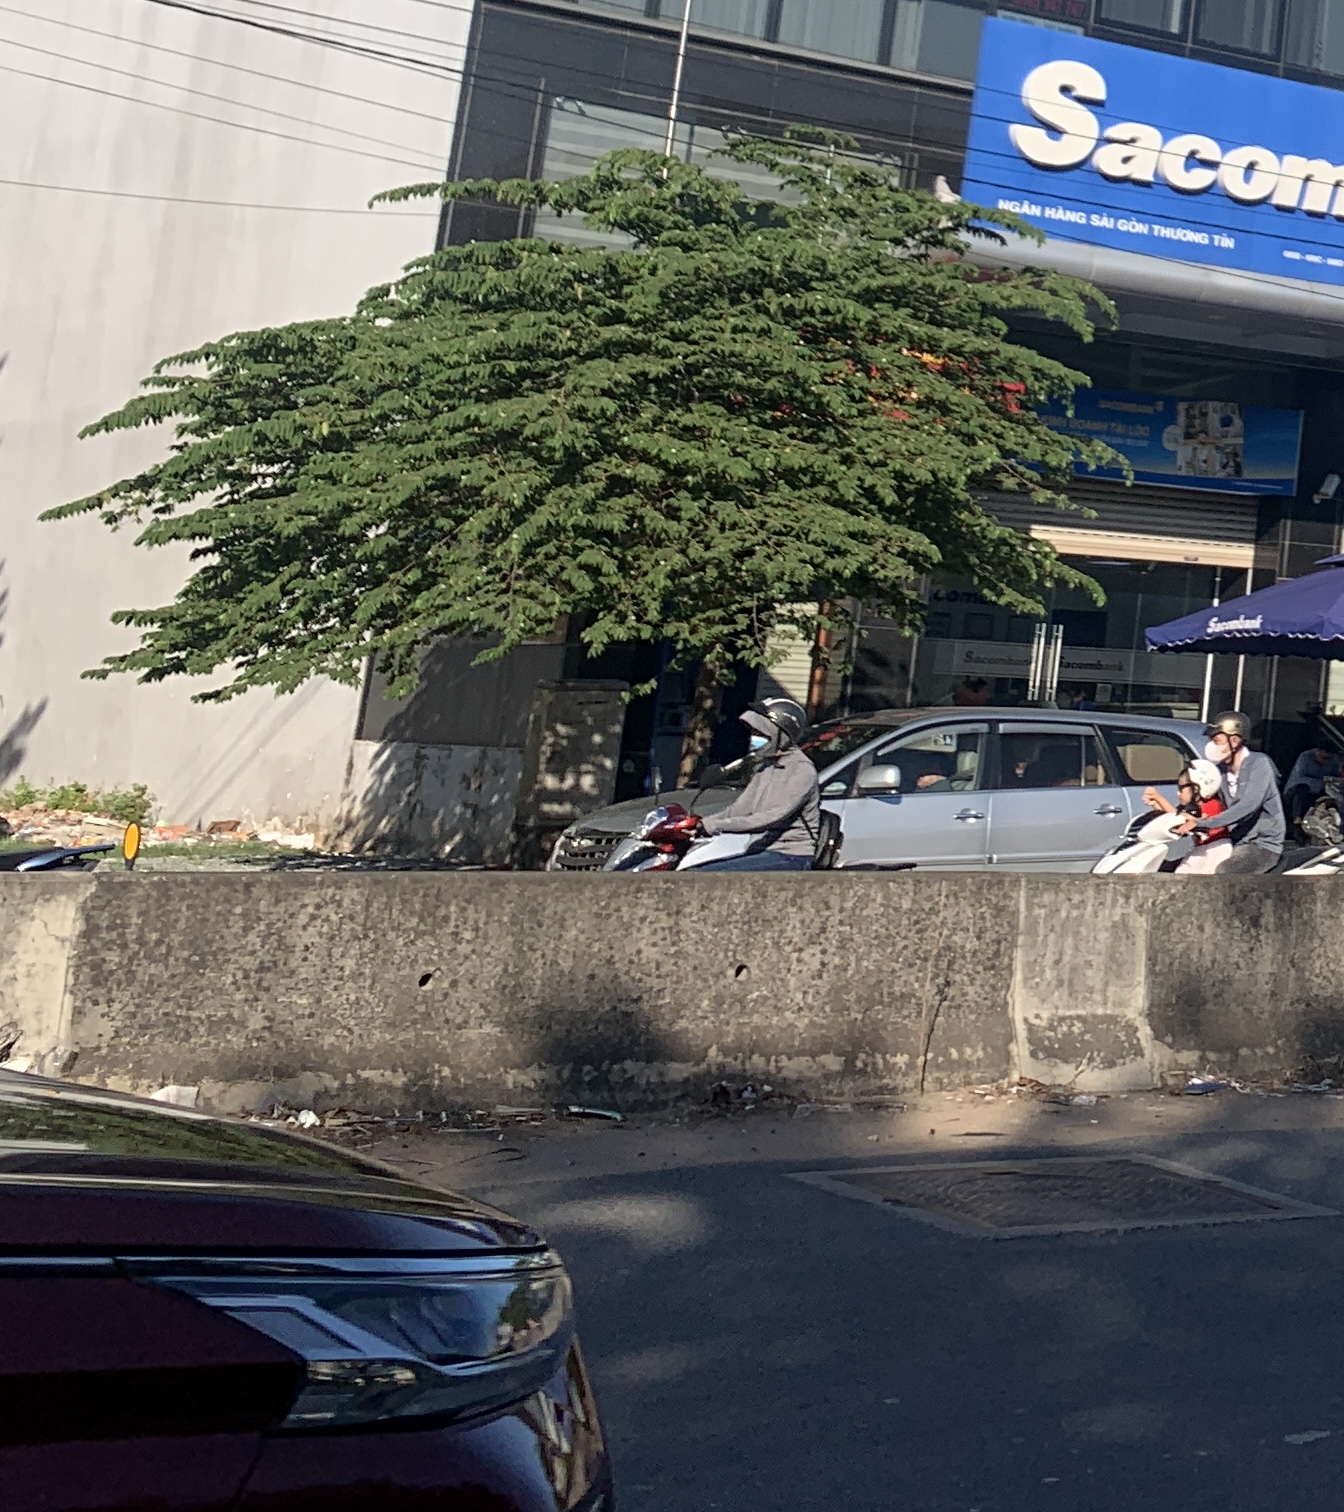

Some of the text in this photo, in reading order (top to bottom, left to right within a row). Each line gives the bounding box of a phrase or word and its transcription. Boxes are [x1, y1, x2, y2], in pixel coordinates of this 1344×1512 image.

[998, 199, 1236, 250] NGÂN HÀNG SÀI GÒN THƯƠNG TÍN
